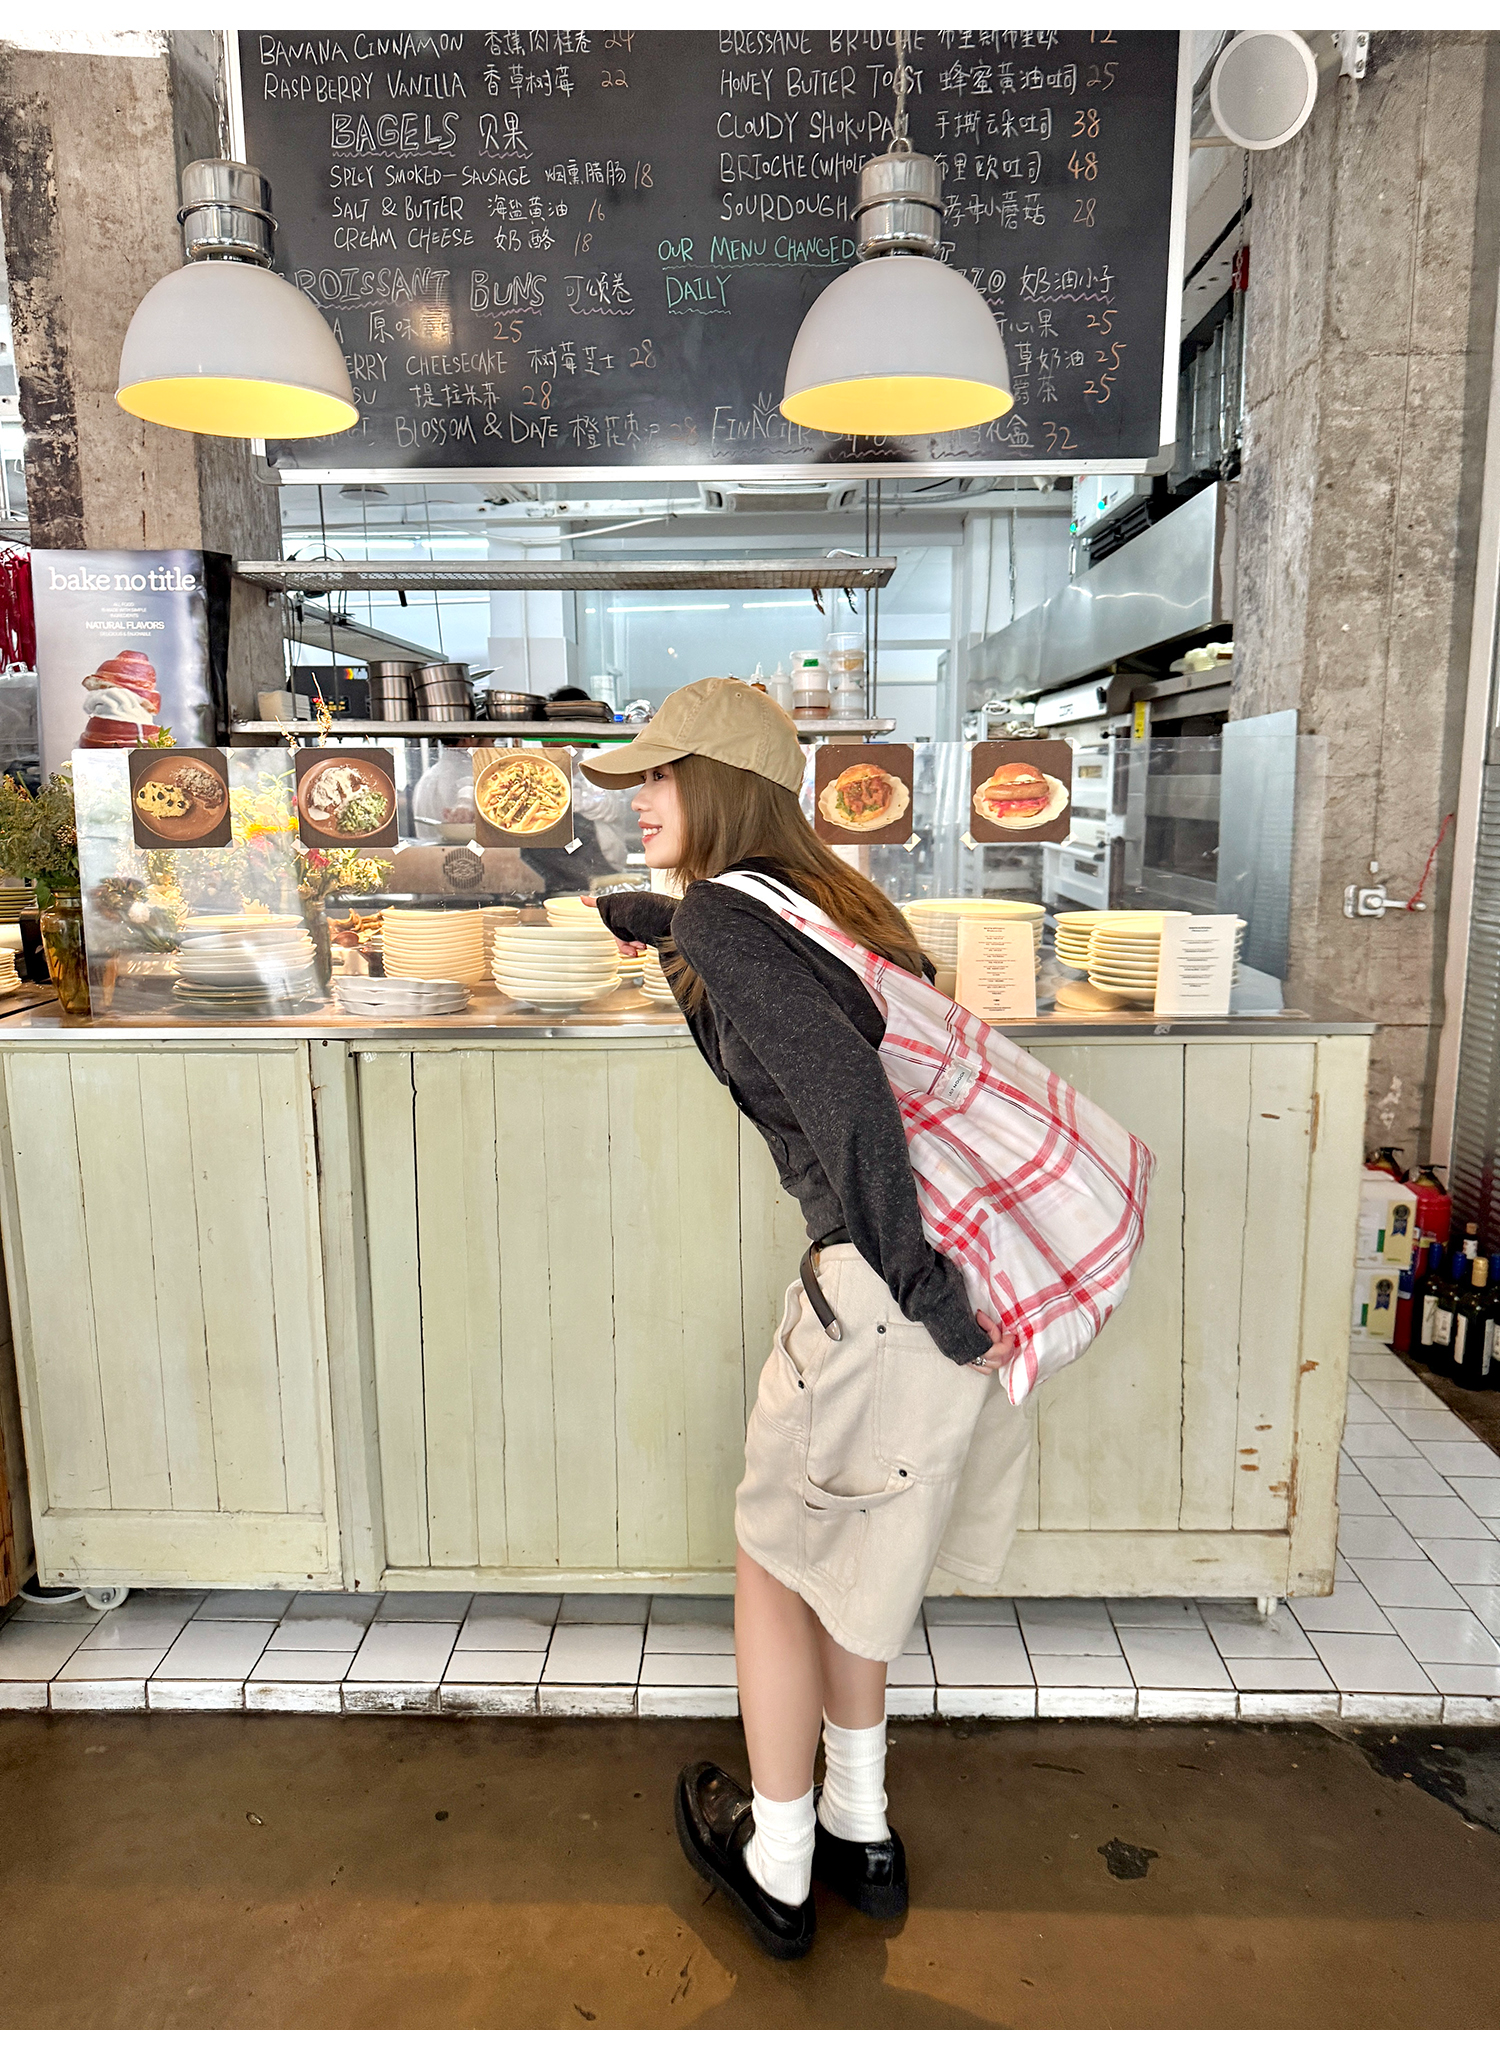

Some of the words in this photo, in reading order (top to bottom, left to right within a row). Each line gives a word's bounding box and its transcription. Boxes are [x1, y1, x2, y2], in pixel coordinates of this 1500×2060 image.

[259, 33, 349, 67] BANANA
[354, 32, 463, 59] CINNAMON
[387, 70, 466, 98] VANILLA
[484, 64, 574, 98] 香草树莓
[601, 69, 629, 88] 22
[721, 68, 773, 101] HONEY
[787, 66, 856, 99] BUTTER
[939, 59, 1077, 97] 蜂蜜黄油吐司
[1086, 61, 1119, 91] 25
[331, 112, 460, 151] BAGELS
[479, 112, 529, 150] 贝果
[717, 111, 799, 143] CLOUDY
[1074, 108, 1100, 138] 38
[330, 165, 374, 188] SPICY
[634, 161, 654, 190] 18
[1068, 150, 1099, 181] 48
[332, 197, 370, 222] SALT
[381, 197, 398, 216] &
[405, 195, 464, 221] BUTTER
[487, 194, 568, 225] 海盐黄油
[588, 199, 606, 223] 16
[720, 193, 848, 222] SOURDOUGH
[1073, 198, 1097, 227] 28
[334, 226, 397, 251] CREAM
[407, 227, 475, 254] CHEESE
[493, 226, 556, 251] 奶酪
[574, 231, 593, 257] 18
[658, 237, 694, 261] OUR
[710, 236, 767, 263] MENU
[774, 236, 856, 264] CHANGED
[276, 267, 450, 306] ROISSANT
[470, 270, 547, 311] BUNS
[564, 272, 633, 307] 可颂卷
[666, 274, 732, 308] DAILY
[494, 320, 524, 343] 25
[1087, 310, 1118, 335] 25
[405, 350, 507, 376] CHEESECAKE
[527, 341, 616, 378] 树莓芝士
[629, 339, 656, 368] 28
[1095, 342, 1127, 371] 25
[409, 382, 500, 410] 提拉米苏
[522, 381, 552, 409] 28
[1083, 373, 1117, 404] 25
[396, 415, 477, 447] BLOSSOM
[484, 412, 503, 439] &
[510, 412, 558, 448] DATE
[1042, 422, 1078, 452] 32
[49, 566, 111, 591] bake
[114, 572, 146, 591] no
[85, 621, 125, 630] NATURAL
[126, 621, 165, 630] FLAVORS
